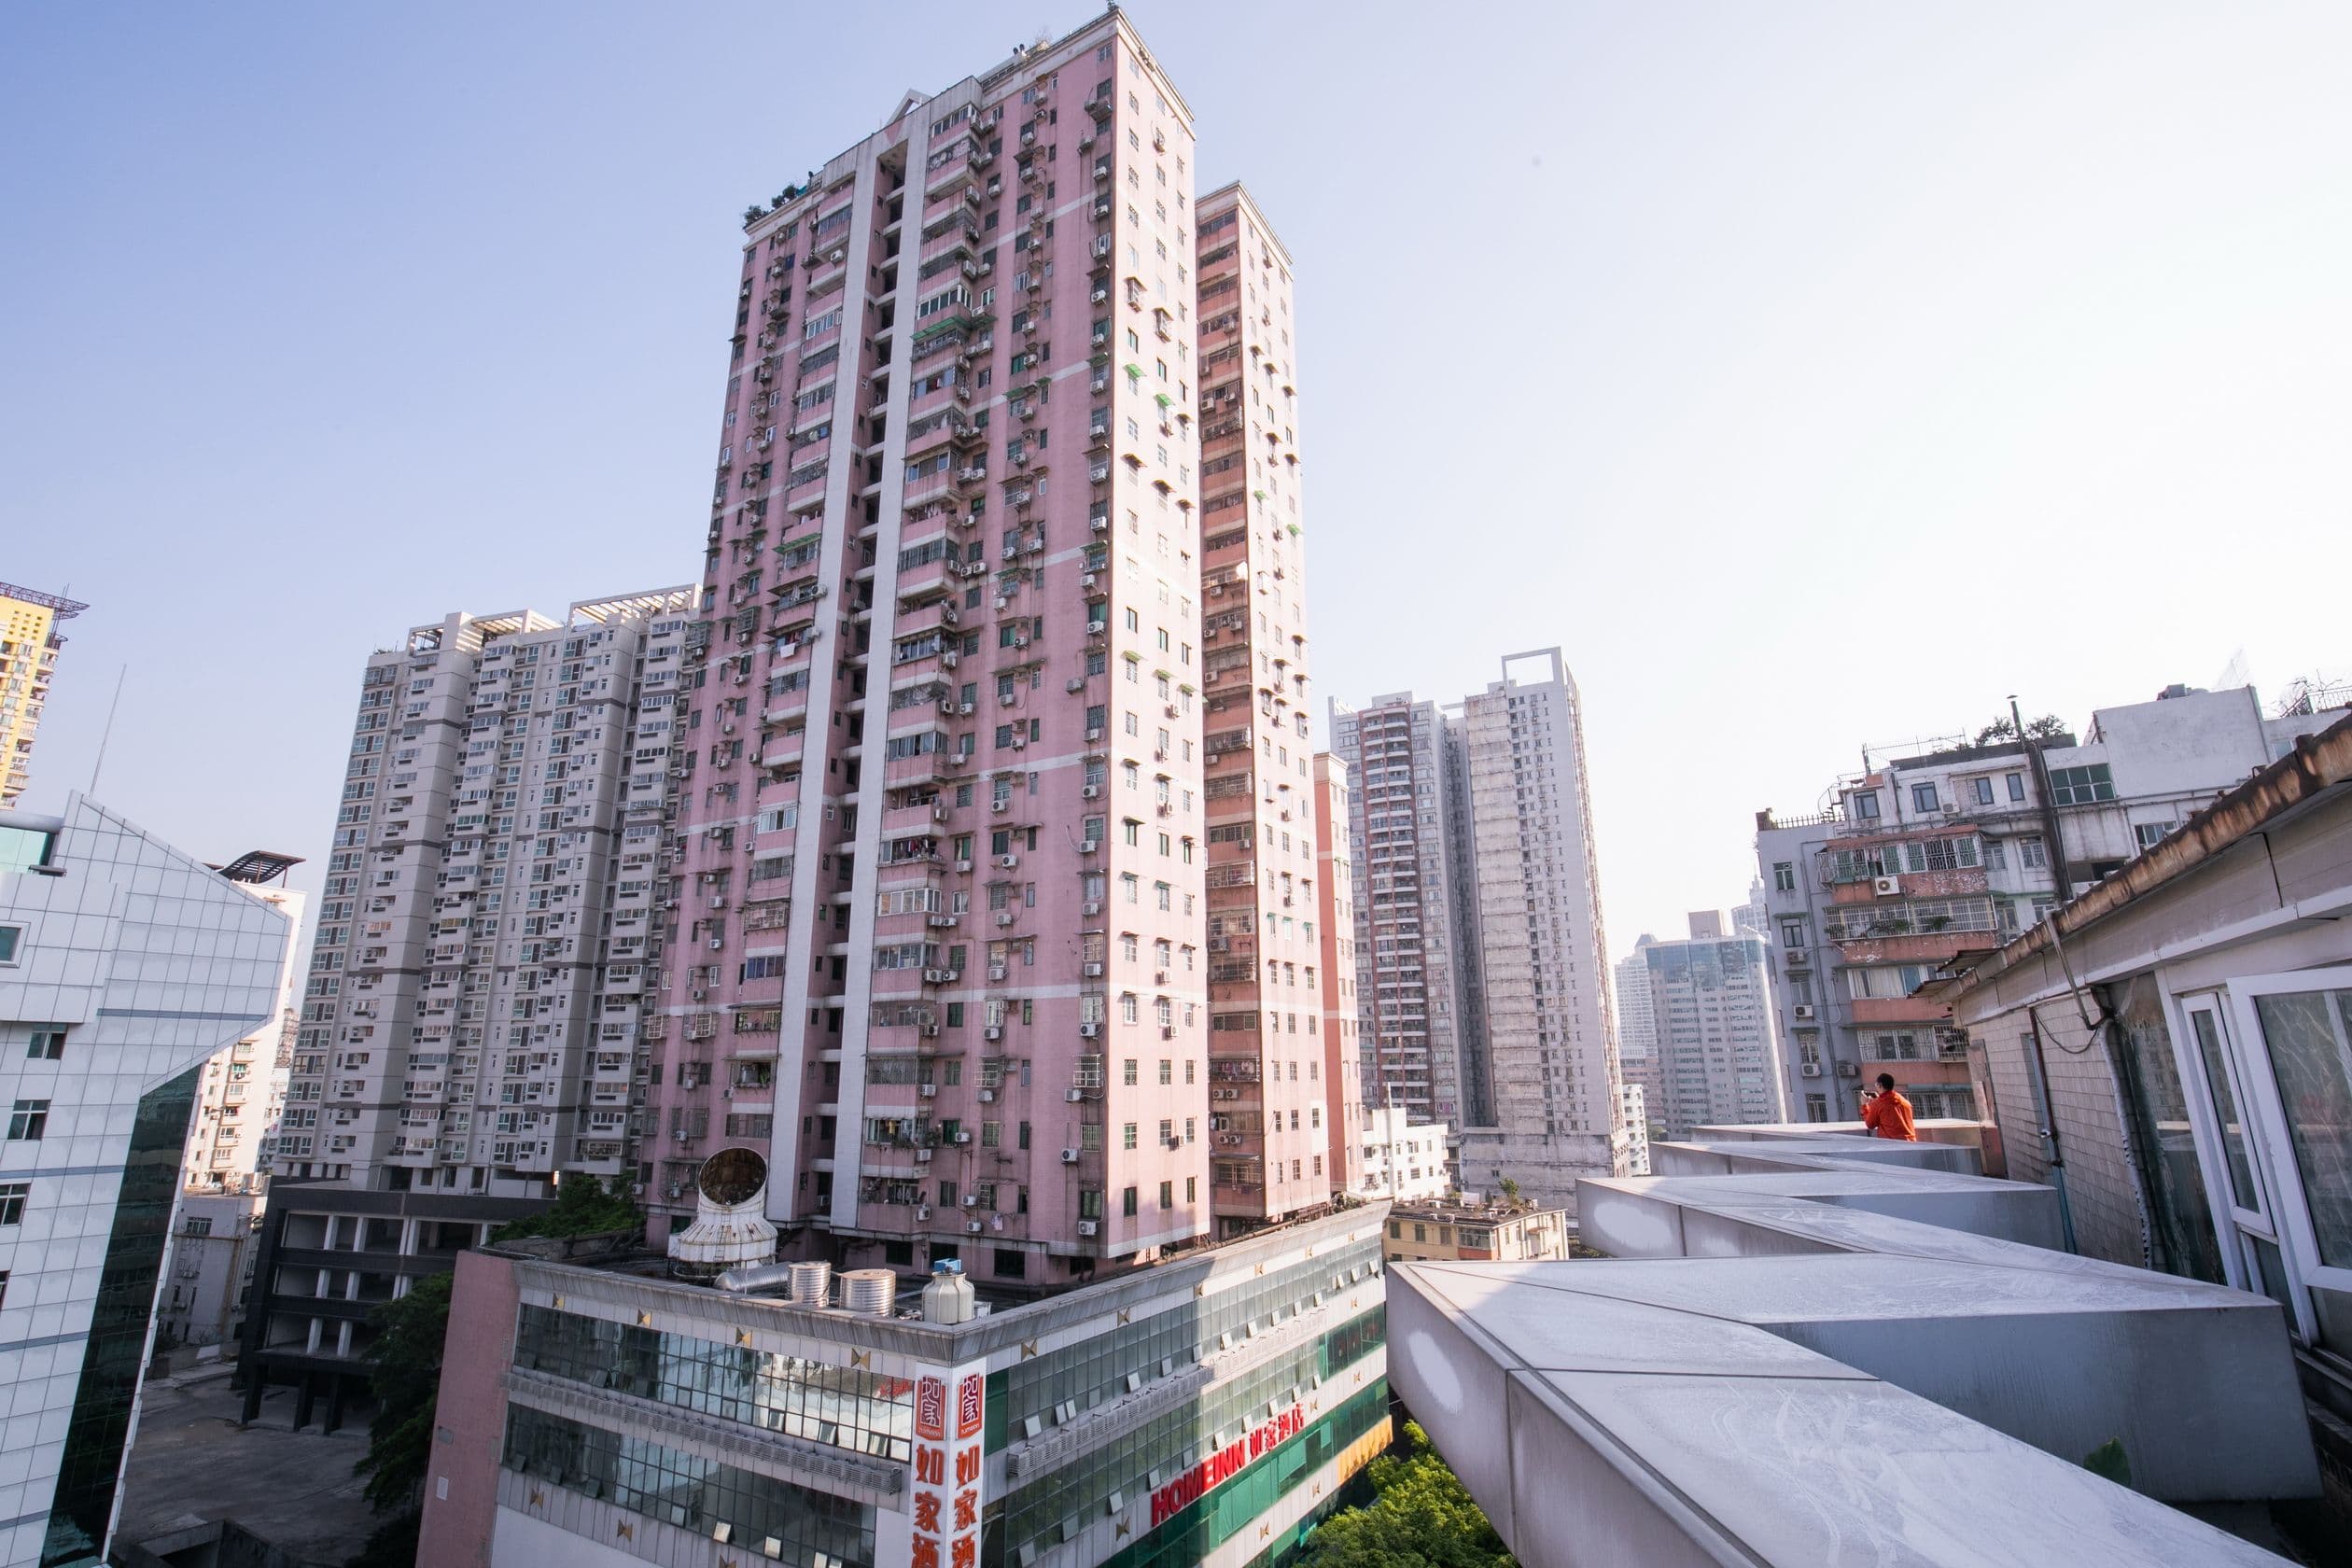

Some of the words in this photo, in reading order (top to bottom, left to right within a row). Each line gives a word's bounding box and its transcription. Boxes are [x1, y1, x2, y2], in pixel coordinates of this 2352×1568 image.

[1151, 1438, 1245, 1527] HOMEINN
[1249, 1403, 1304, 1461] 如家酒店
